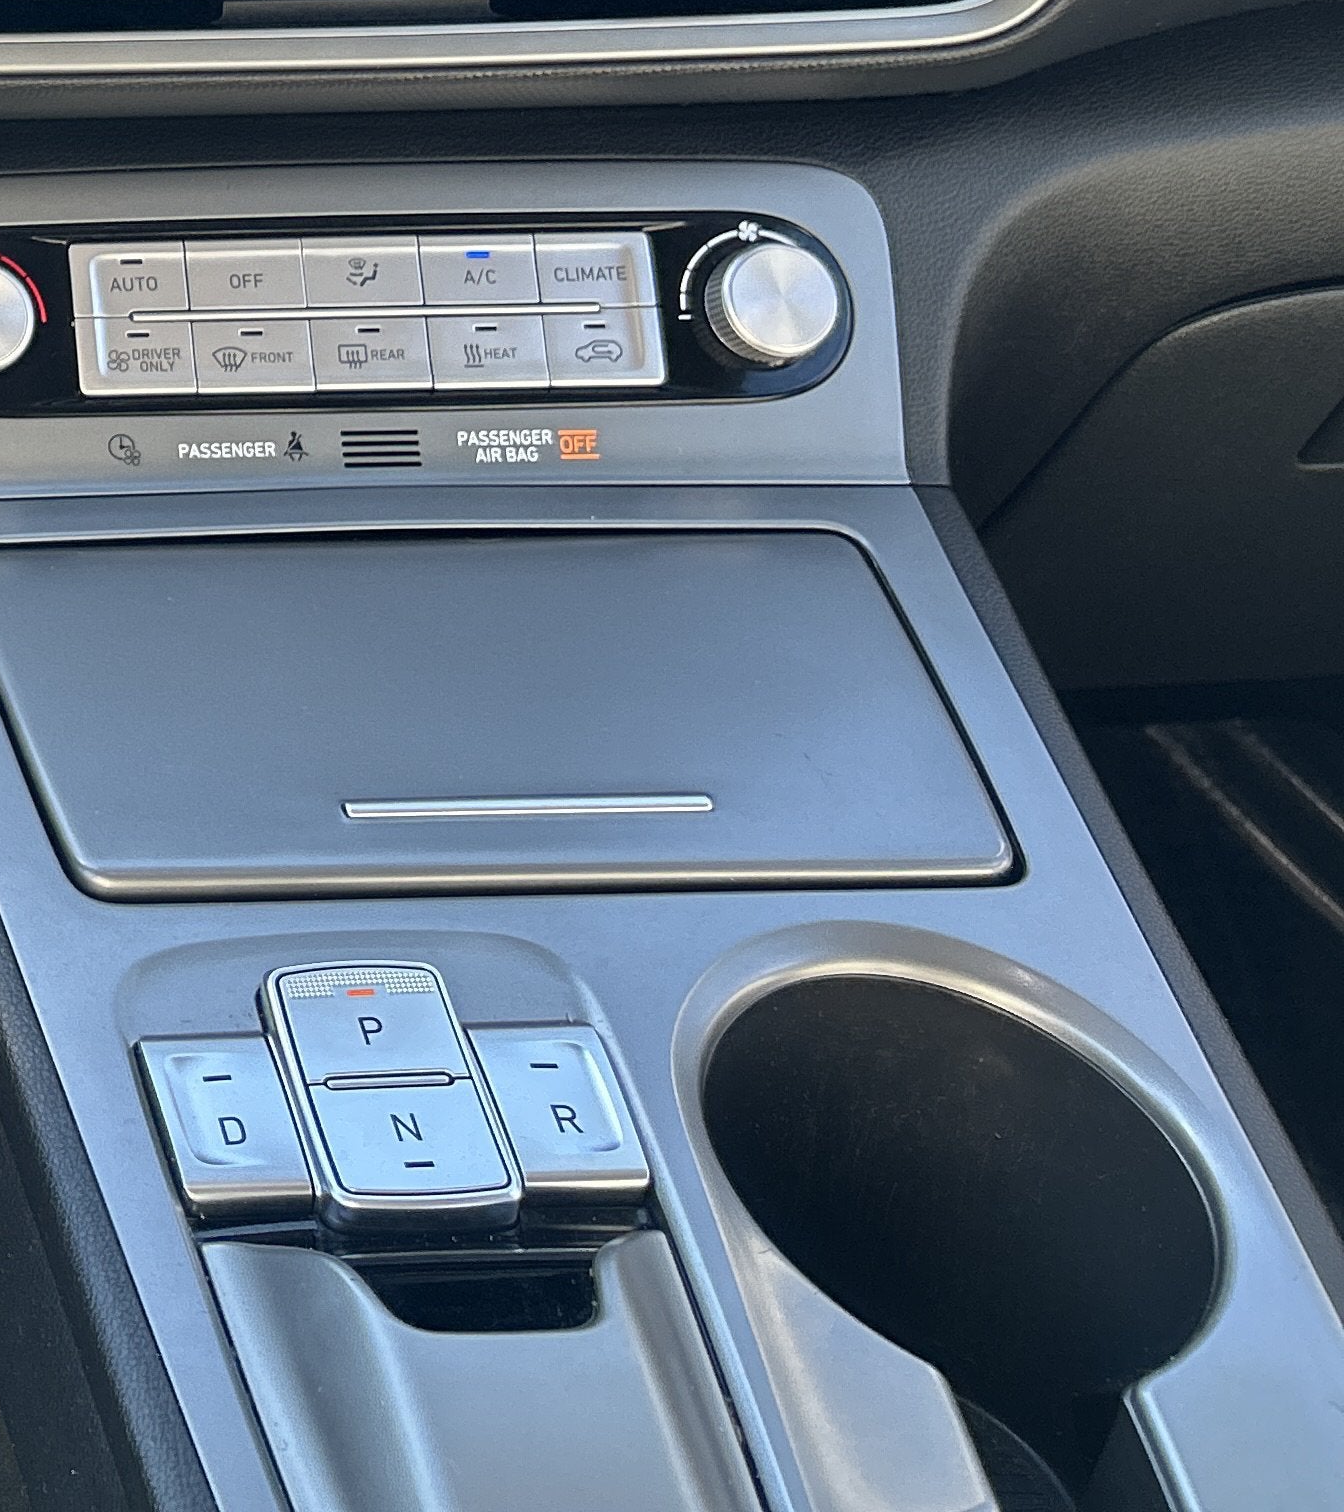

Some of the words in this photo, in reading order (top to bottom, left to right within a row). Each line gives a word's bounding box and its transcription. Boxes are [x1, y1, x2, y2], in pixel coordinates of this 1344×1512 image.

[229, 273, 263, 289] OFF
[464, 269, 497, 285] A/C
[553, 266, 627, 282] CLIMATE
[110, 276, 157, 292] AUTO
[132, 348, 180, 361] DRIVER
[251, 350, 293, 363] FRONT
[371, 348, 405, 361] REAR
[484, 346, 517, 359] HEAT
[140, 359, 175, 373] ONLY
[457, 429, 553, 447] PASSENGER
[560, 435, 597, 454] OFF
[178, 441, 276, 459] PASSENGER
[475, 448, 503, 463] AIR
[505, 447, 539, 461] BAG
[357, 1016, 383, 1045] P
[390, 1112, 423, 1142] N
[550, 1104, 584, 1134] R
[219, 1116, 247, 1145] D
